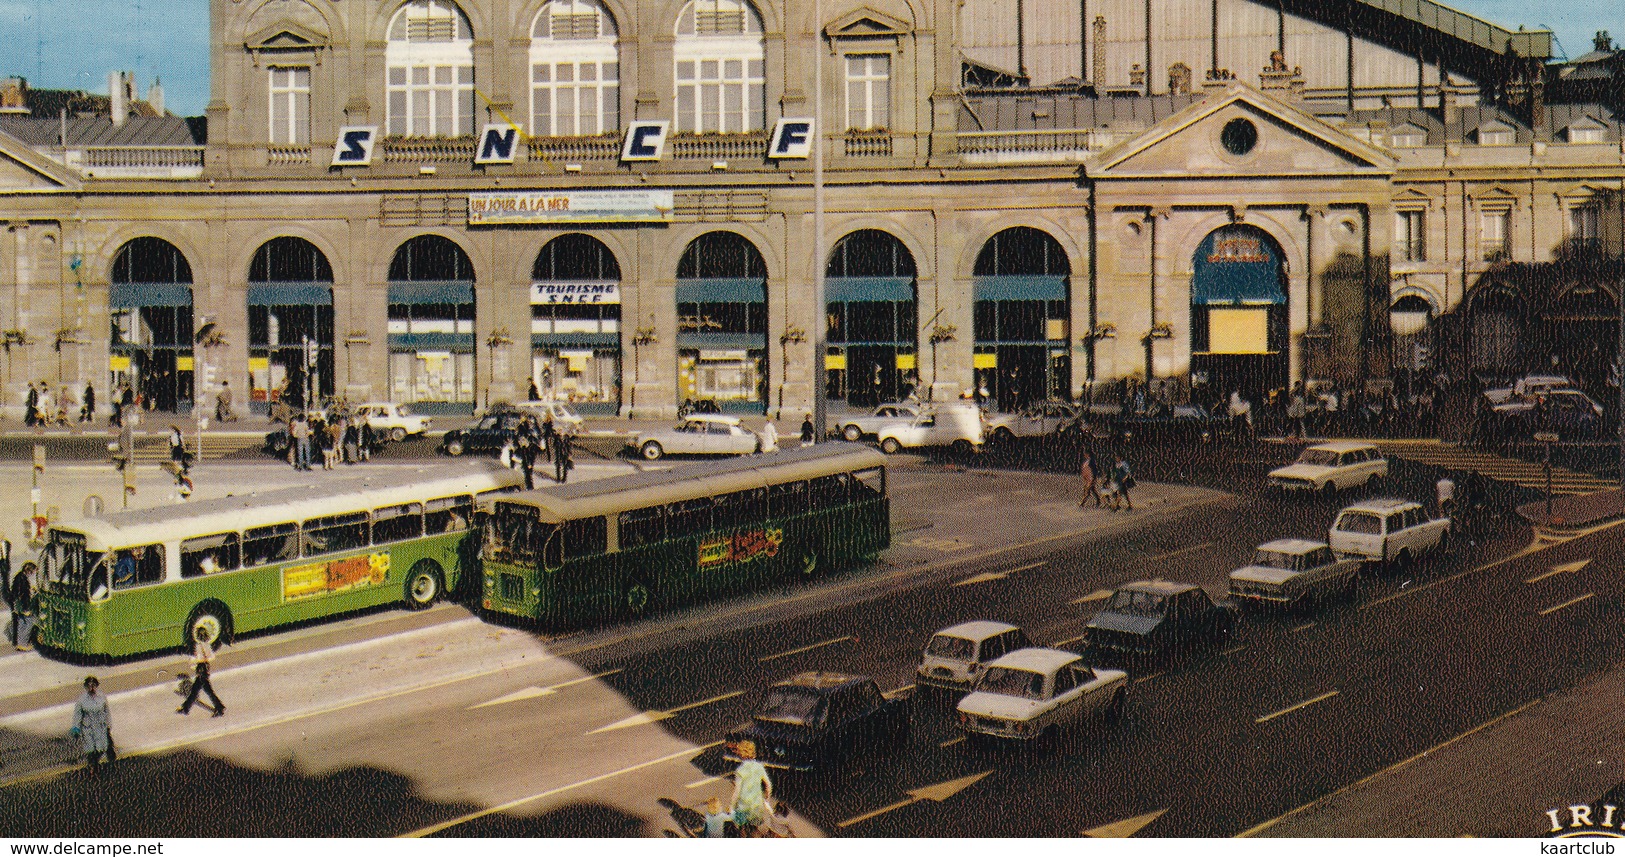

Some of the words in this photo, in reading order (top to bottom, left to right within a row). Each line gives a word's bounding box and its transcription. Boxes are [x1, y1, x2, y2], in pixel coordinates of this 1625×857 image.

[338, 130, 371, 162] S
[480, 128, 517, 159] N
[628, 125, 662, 157] C
[775, 122, 810, 153] F
[471, 198, 486, 211] UN
[487, 197, 517, 211] JOUR
[530, 197, 545, 211] LA
[536, 284, 615, 294] TOURISME
